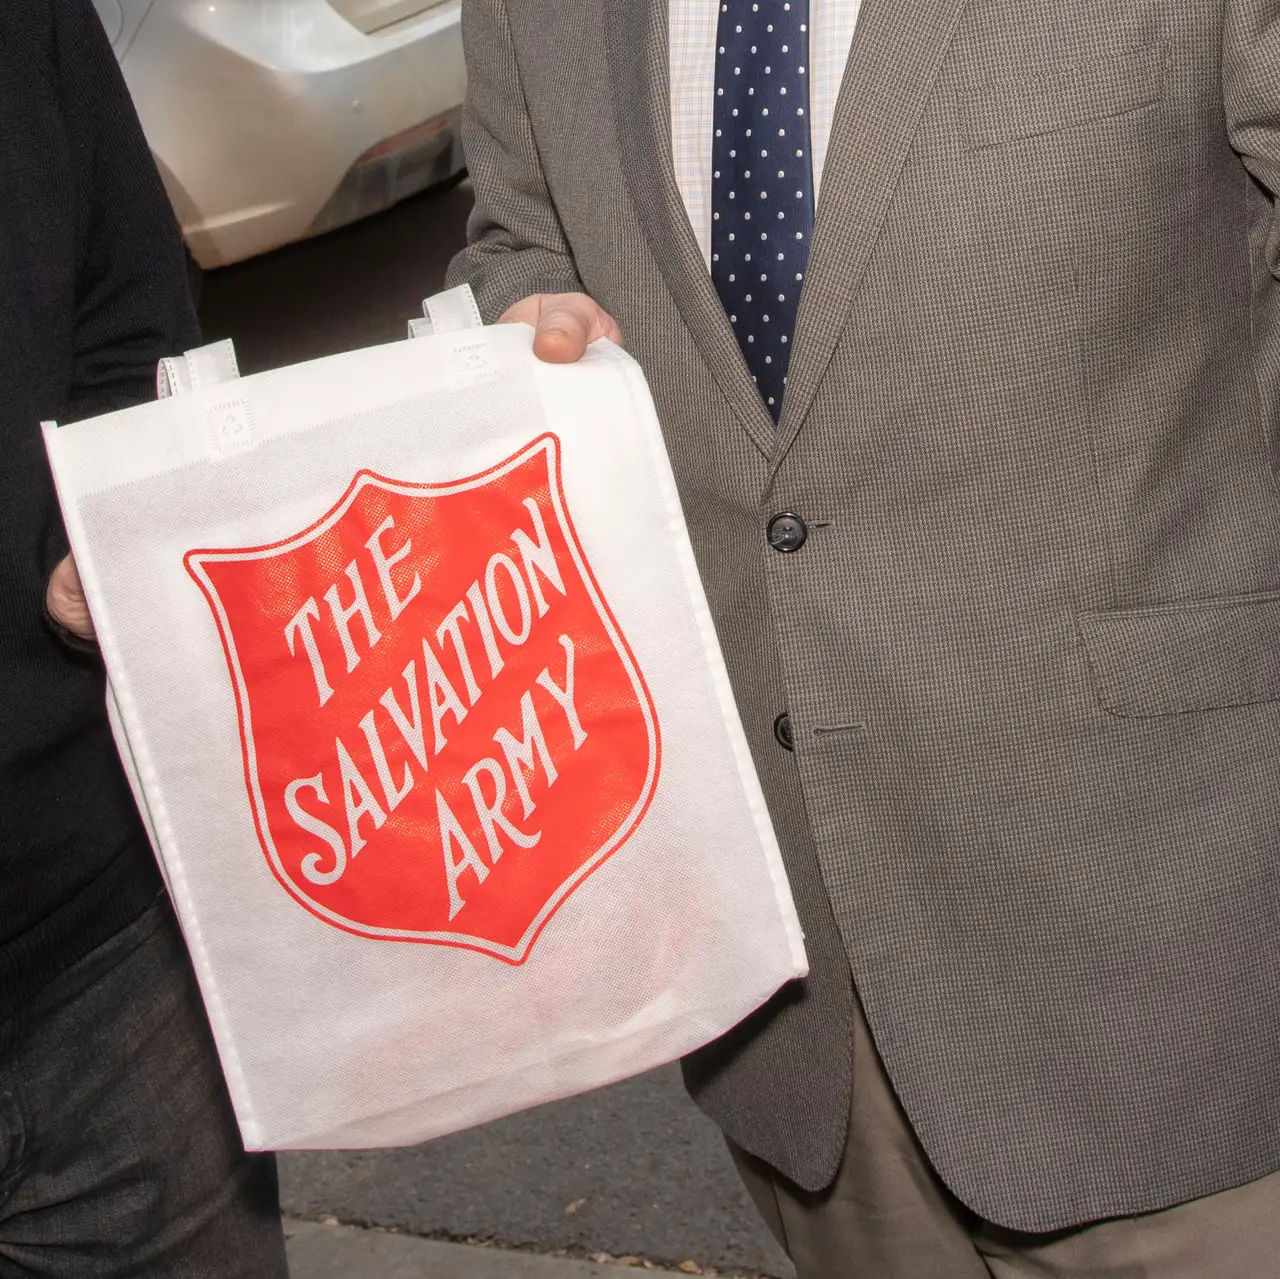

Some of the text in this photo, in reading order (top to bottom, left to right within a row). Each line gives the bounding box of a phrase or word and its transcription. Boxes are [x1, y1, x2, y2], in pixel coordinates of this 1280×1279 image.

[282, 515, 423, 708] THE
[282, 496, 568, 886] SALVATION
[436, 633, 589, 921] ARMY
